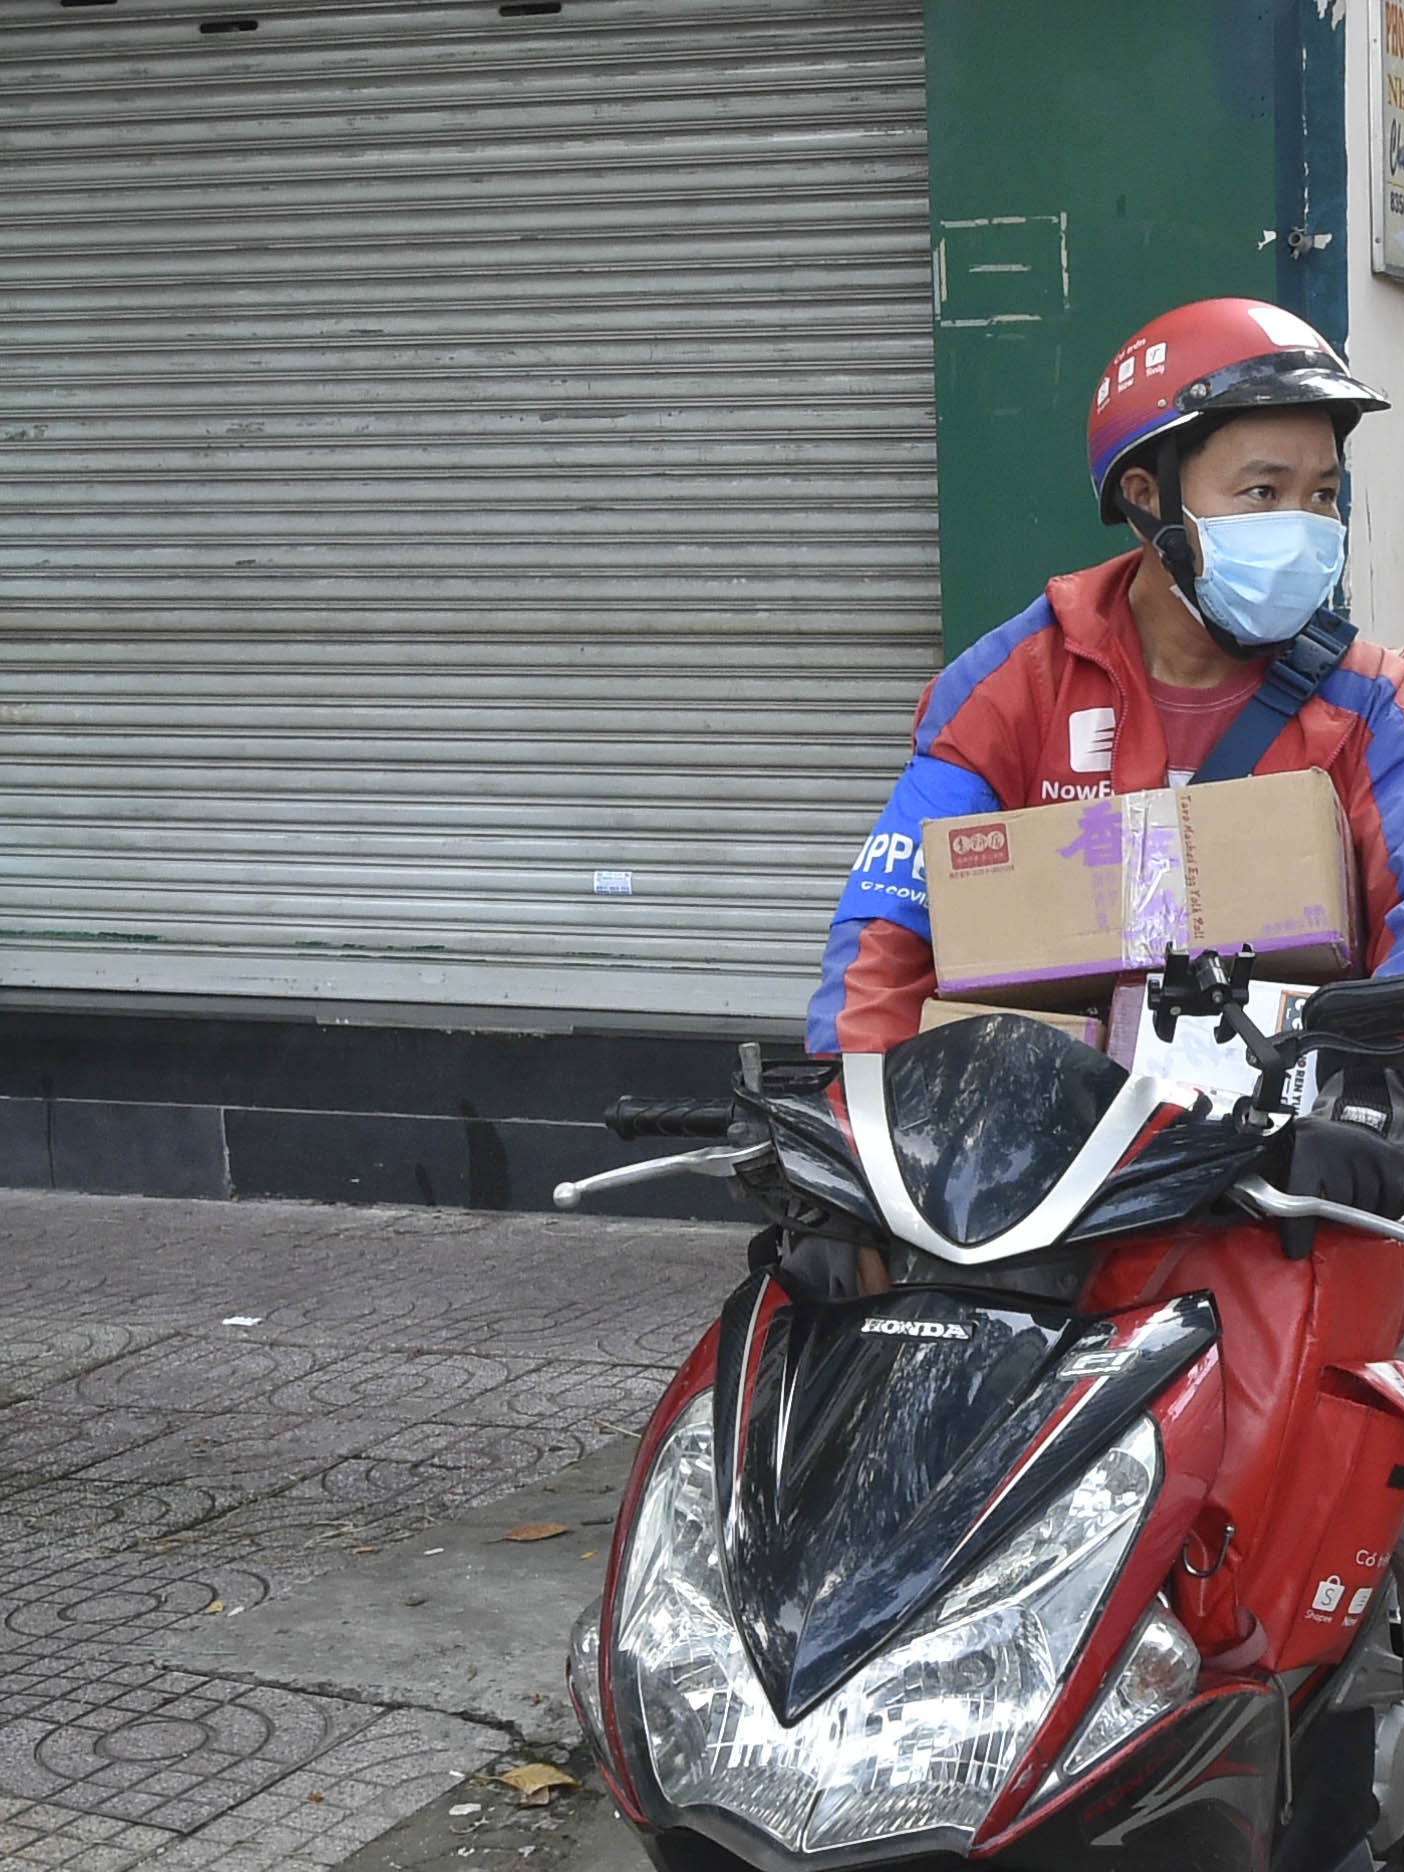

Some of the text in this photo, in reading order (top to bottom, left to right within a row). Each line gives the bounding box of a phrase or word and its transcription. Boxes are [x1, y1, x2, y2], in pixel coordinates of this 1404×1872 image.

[1185, 866, 1200, 887] Egg
[1293, 1069, 1307, 1093] REN
[861, 1318, 969, 1340] HONDA
